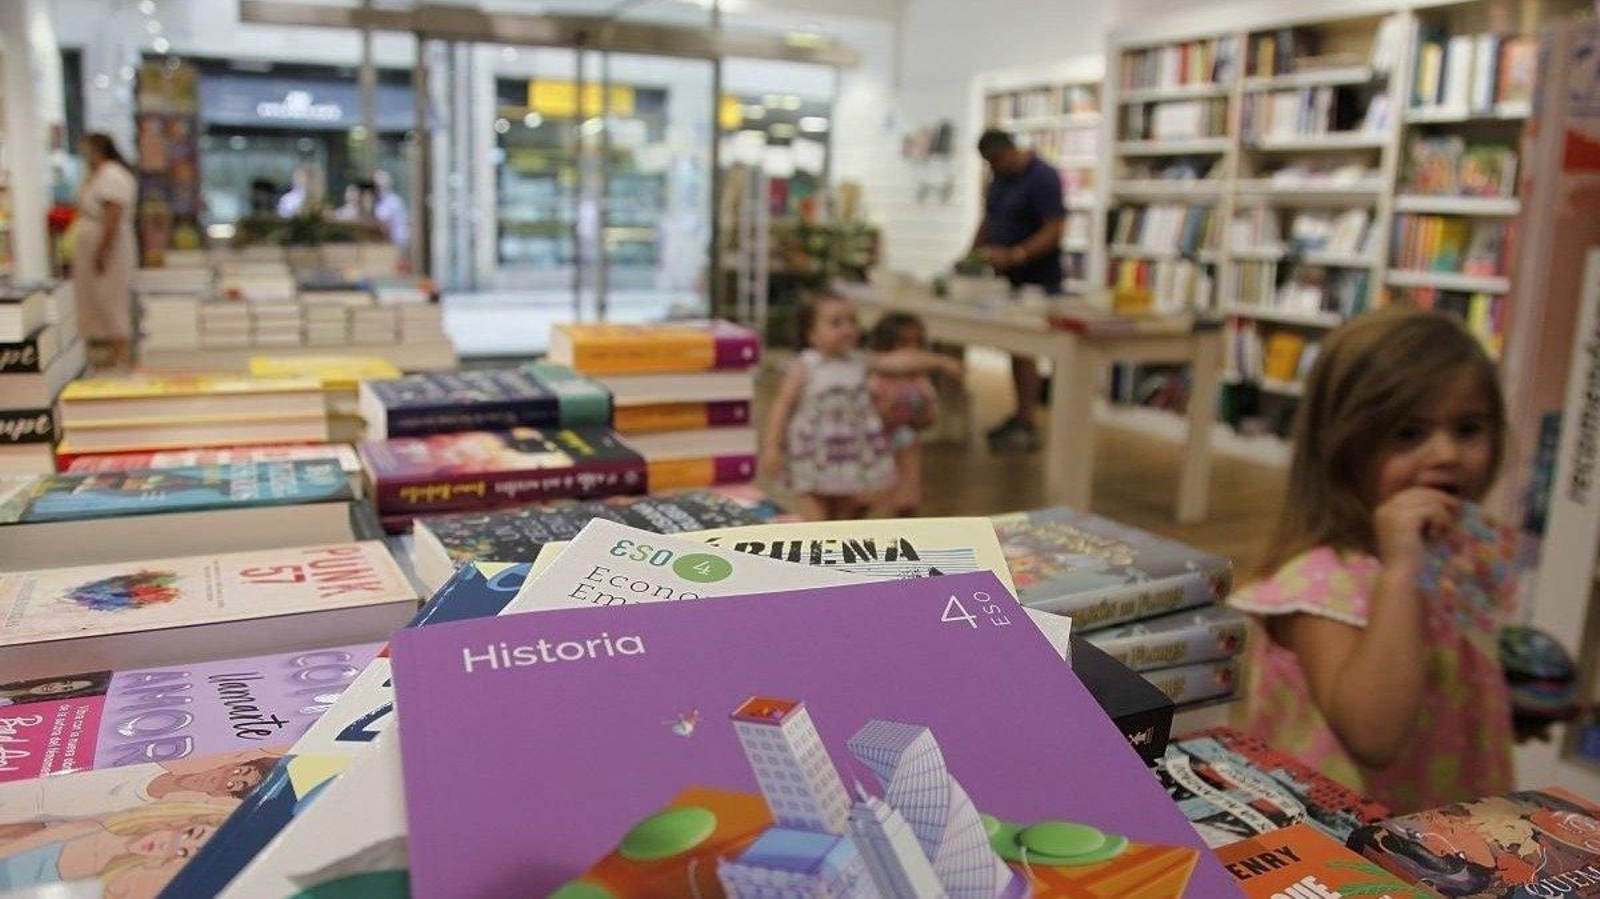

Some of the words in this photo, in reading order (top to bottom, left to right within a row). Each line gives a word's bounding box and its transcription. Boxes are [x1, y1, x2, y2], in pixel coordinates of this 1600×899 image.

[239, 564, 306, 584] 57
[302, 547, 385, 598] PUNK
[692, 560, 712, 577] 4
[568, 583, 641, 607] Em
[940, 594, 979, 629] 4
[973, 591, 1011, 627] ESO
[462, 632, 646, 673] Historia
[112, 670, 195, 768] AMOR
[207, 671, 289, 741] llamarte
